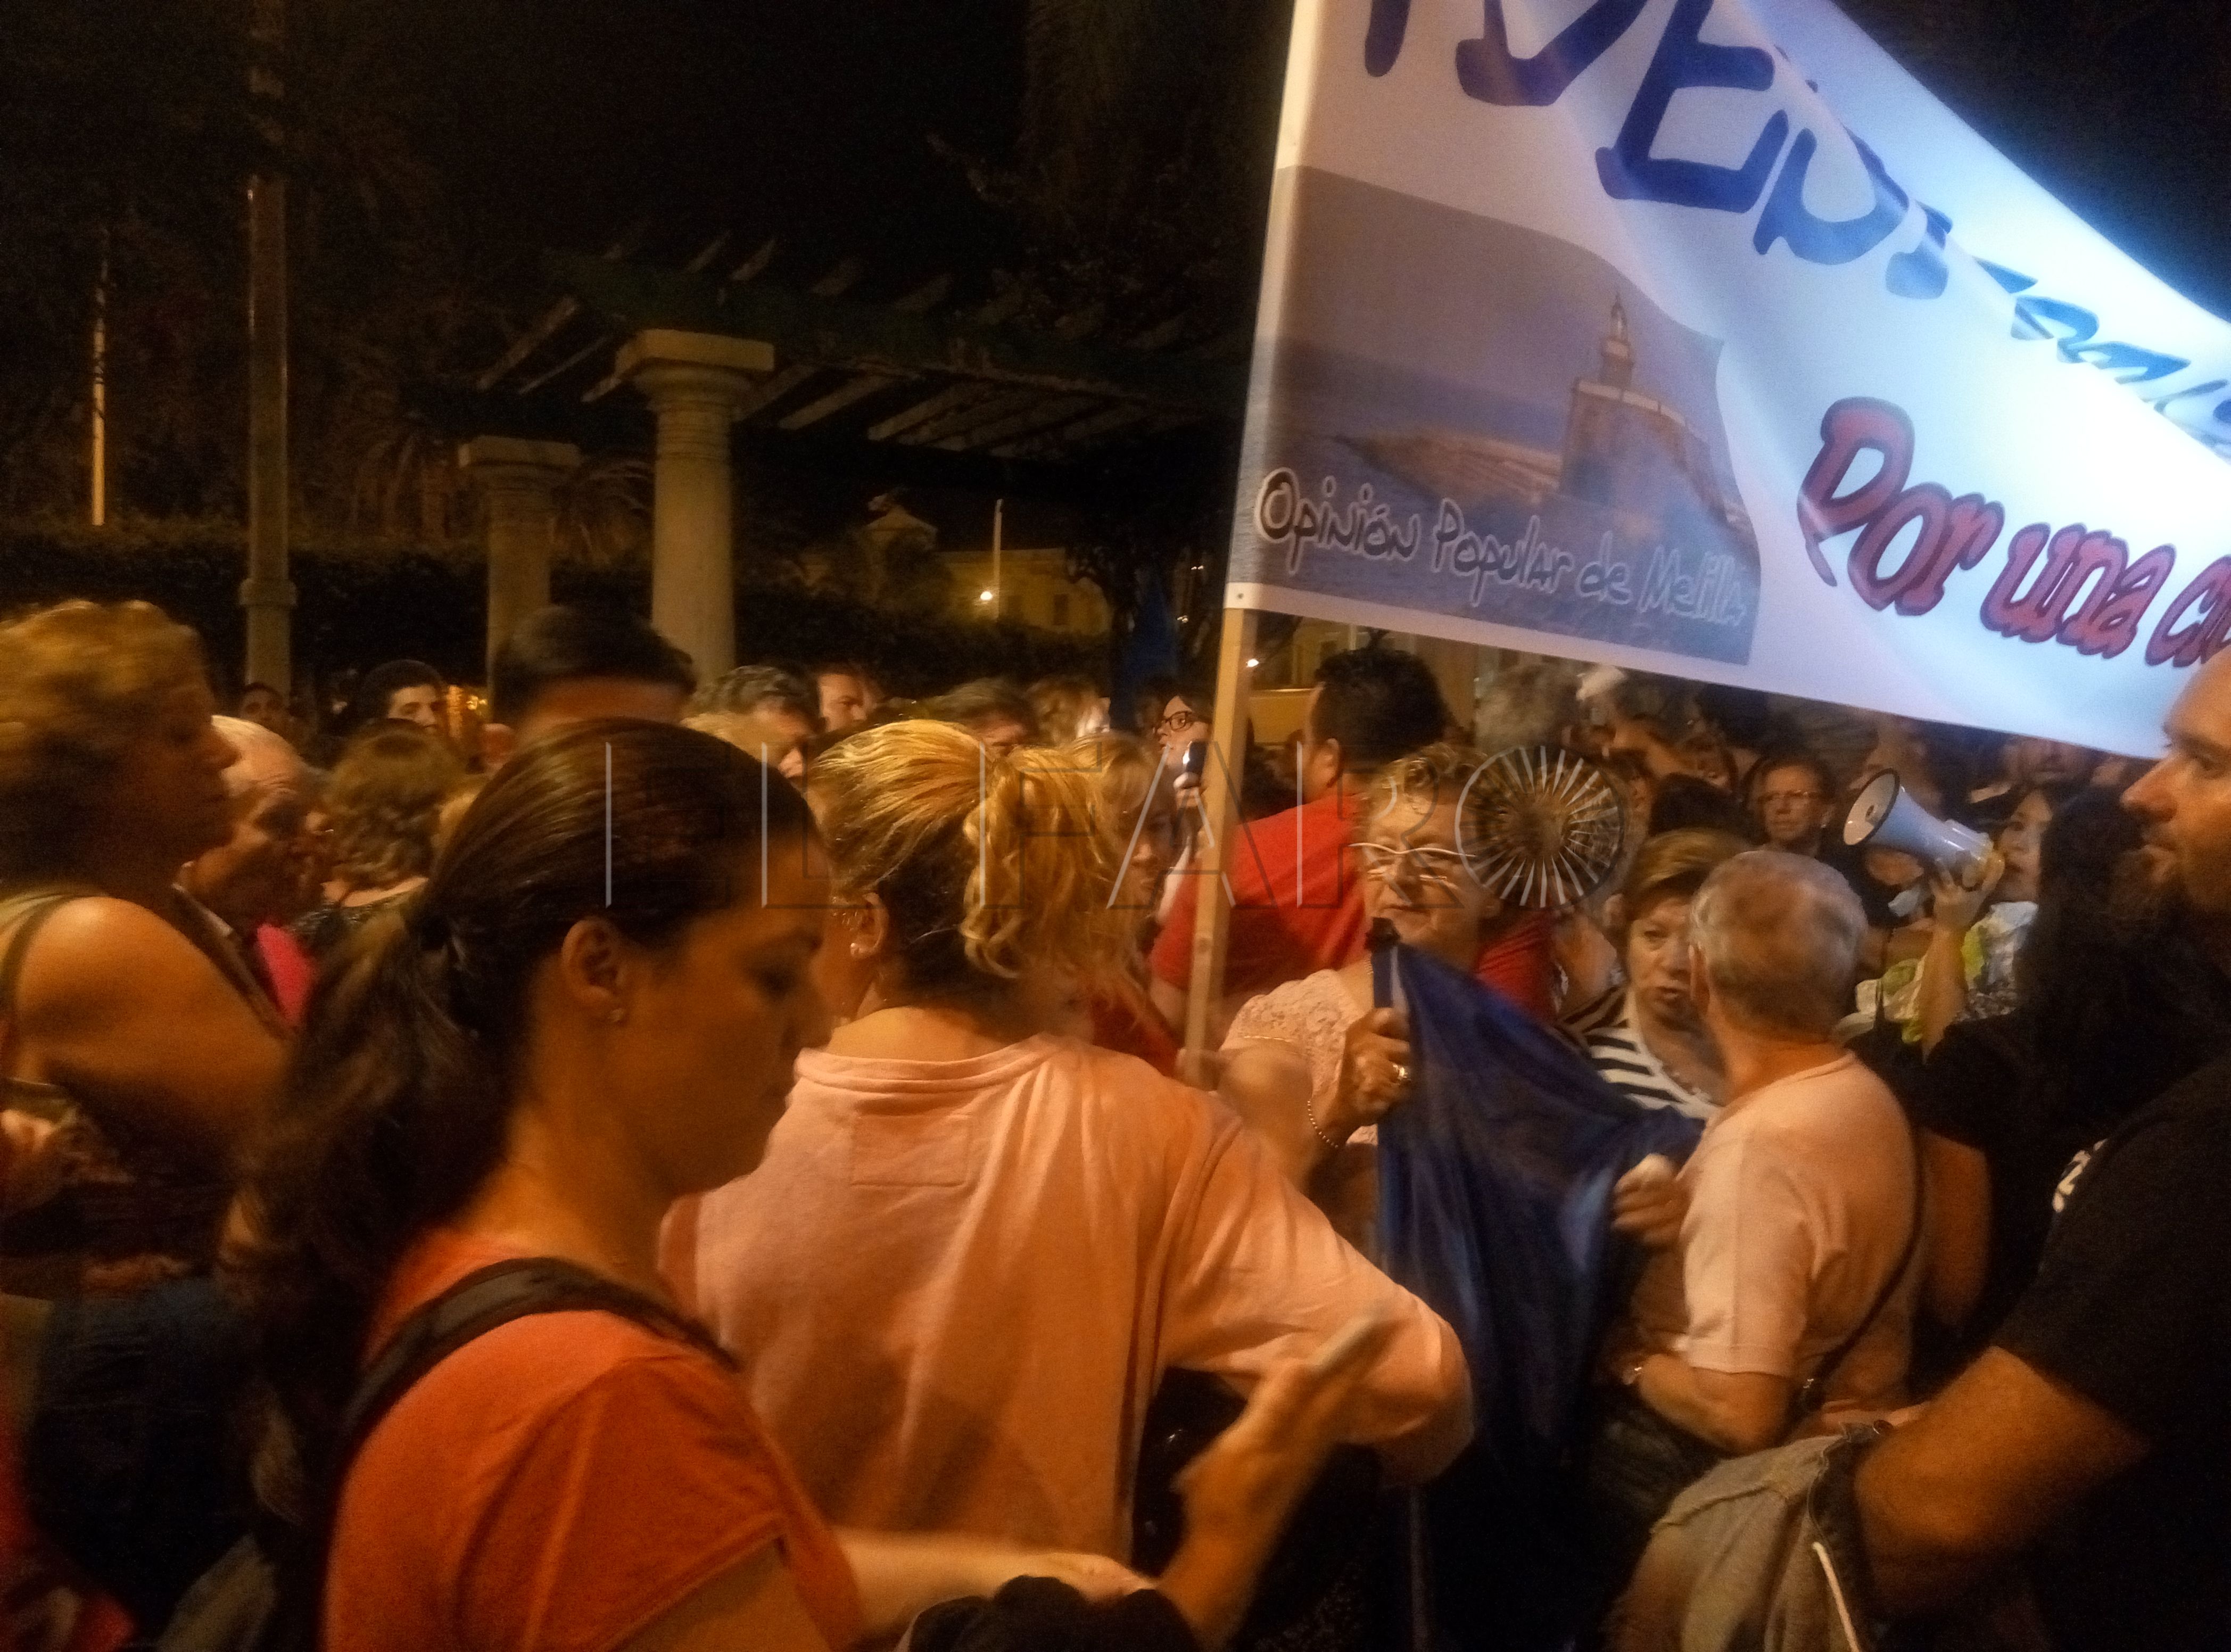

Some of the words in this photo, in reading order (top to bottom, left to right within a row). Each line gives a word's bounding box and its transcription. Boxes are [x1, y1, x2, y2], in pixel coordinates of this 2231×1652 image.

[1431, 498, 1575, 607] Popular
[1574, 531, 1632, 606] de
[1797, 396, 2005, 616] Por
[1980, 522, 2177, 659] una
